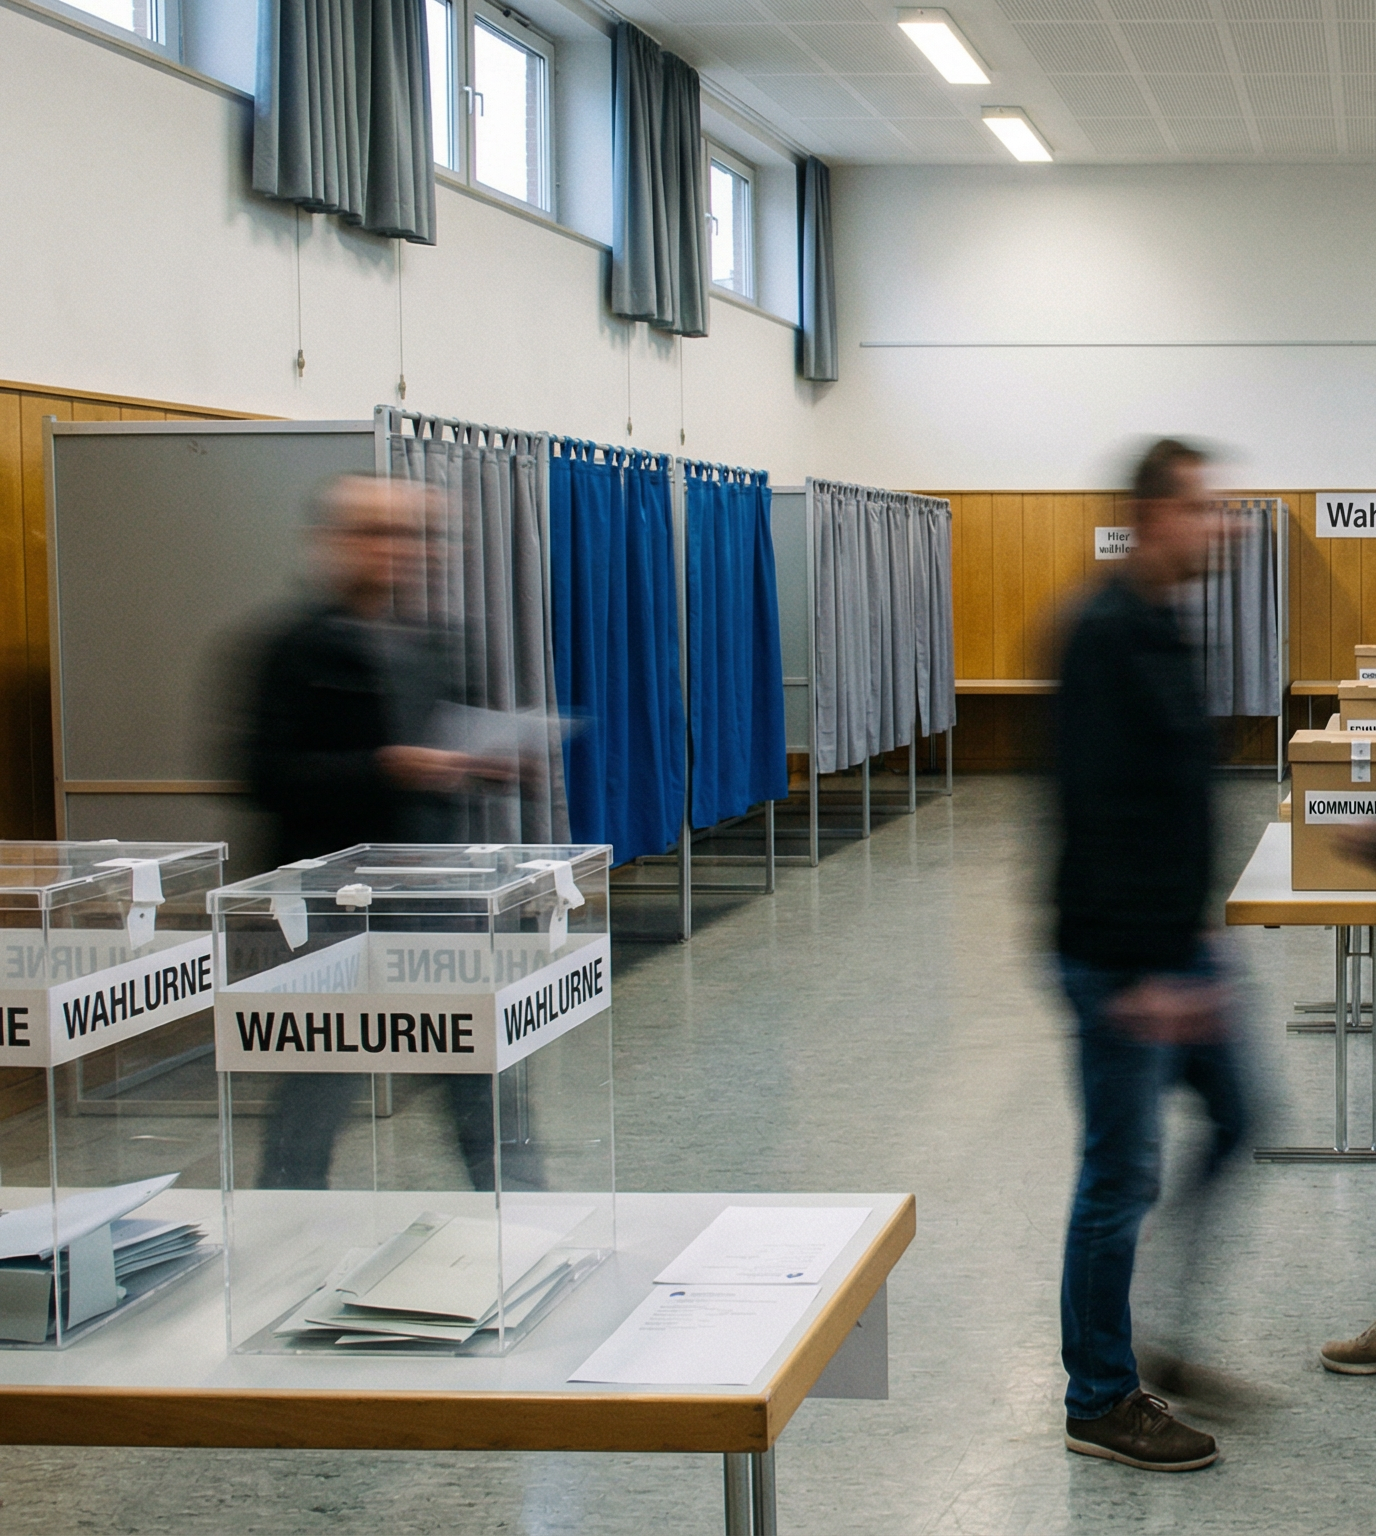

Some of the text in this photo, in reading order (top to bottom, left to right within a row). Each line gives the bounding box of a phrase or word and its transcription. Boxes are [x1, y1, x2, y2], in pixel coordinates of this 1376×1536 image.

[1107, 532, 1130, 541] Hier
[62, 953, 213, 1040] WAHLURNE
[503, 957, 604, 1046] WAHLURNE
[235, 1011, 475, 1053] WAHLURNE
